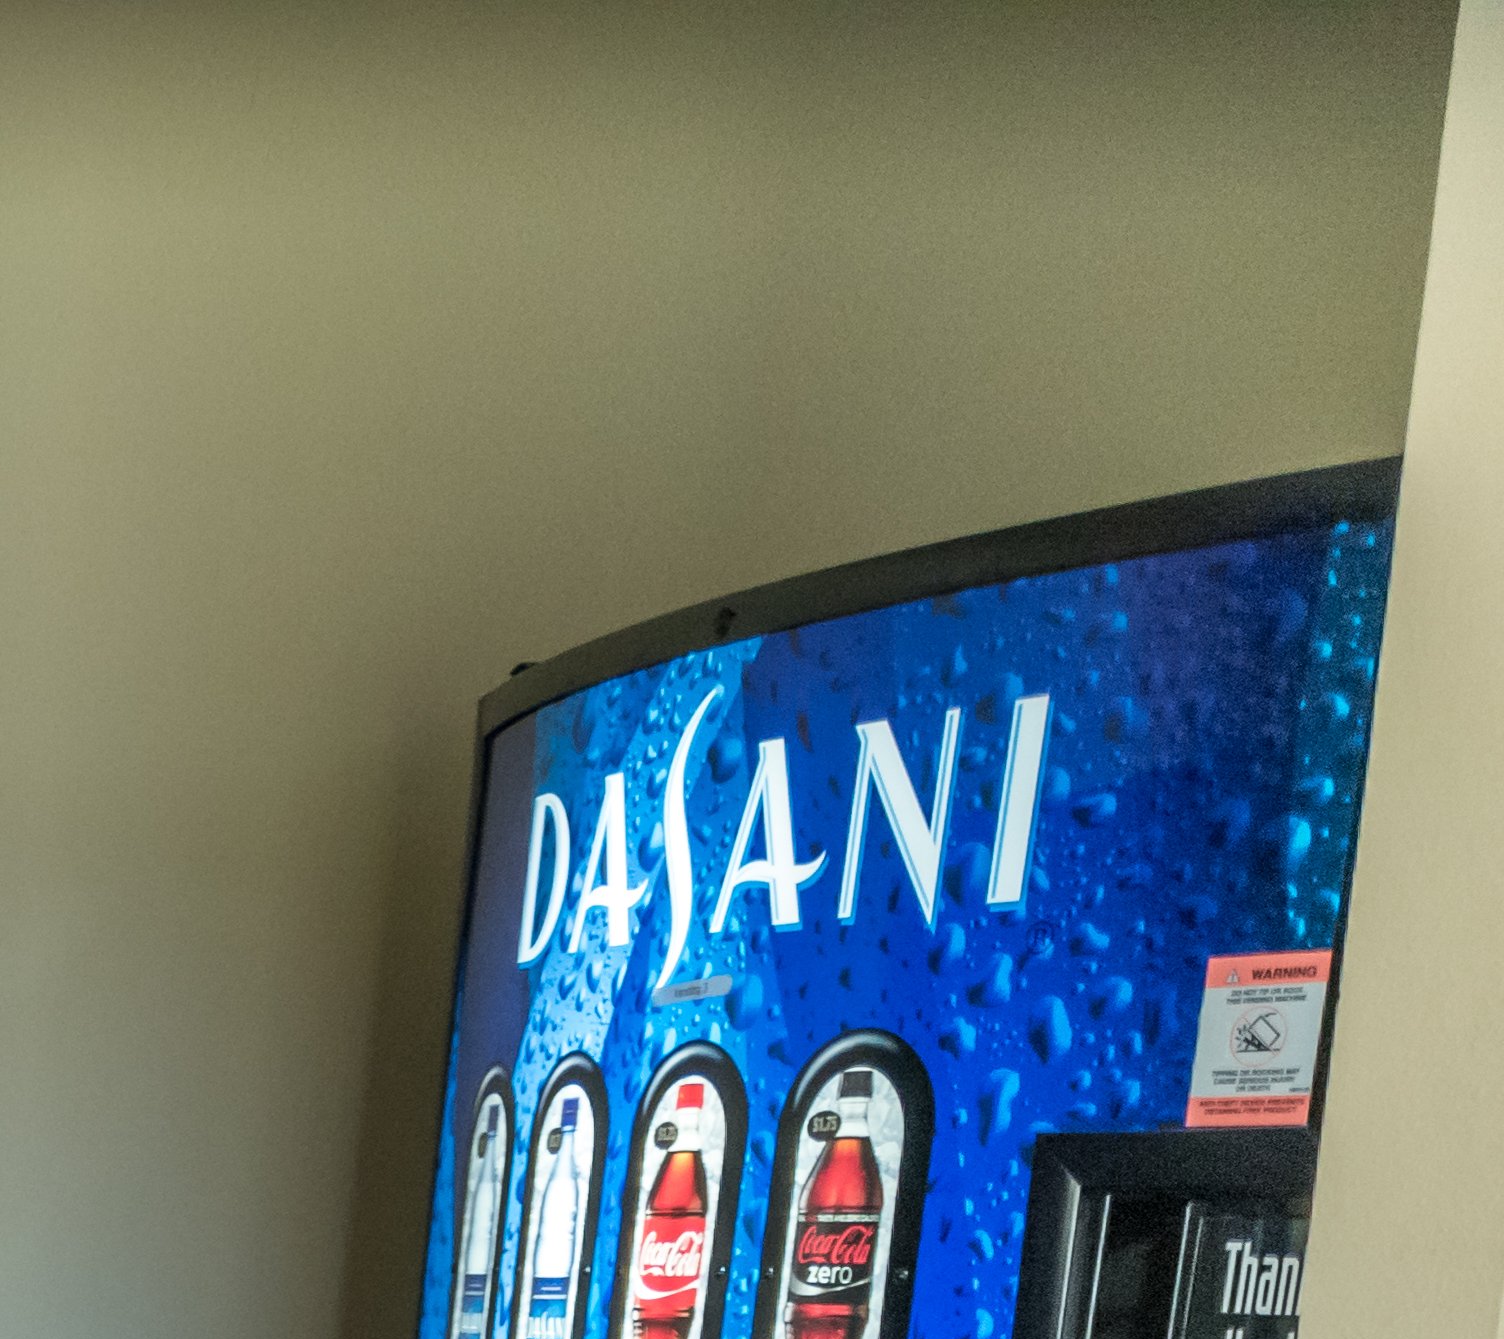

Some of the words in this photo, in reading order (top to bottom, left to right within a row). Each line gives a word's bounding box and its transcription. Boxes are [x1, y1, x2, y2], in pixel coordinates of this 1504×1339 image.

[517, 684, 1051, 994] DASANI
[1252, 966, 1317, 980] WARNING
[638, 1229, 704, 1278] Coca-Cola
[796, 1225, 871, 1266] Coca-Cola
[807, 1262, 853, 1286] zero
[1220, 1241, 1301, 1316] Than
